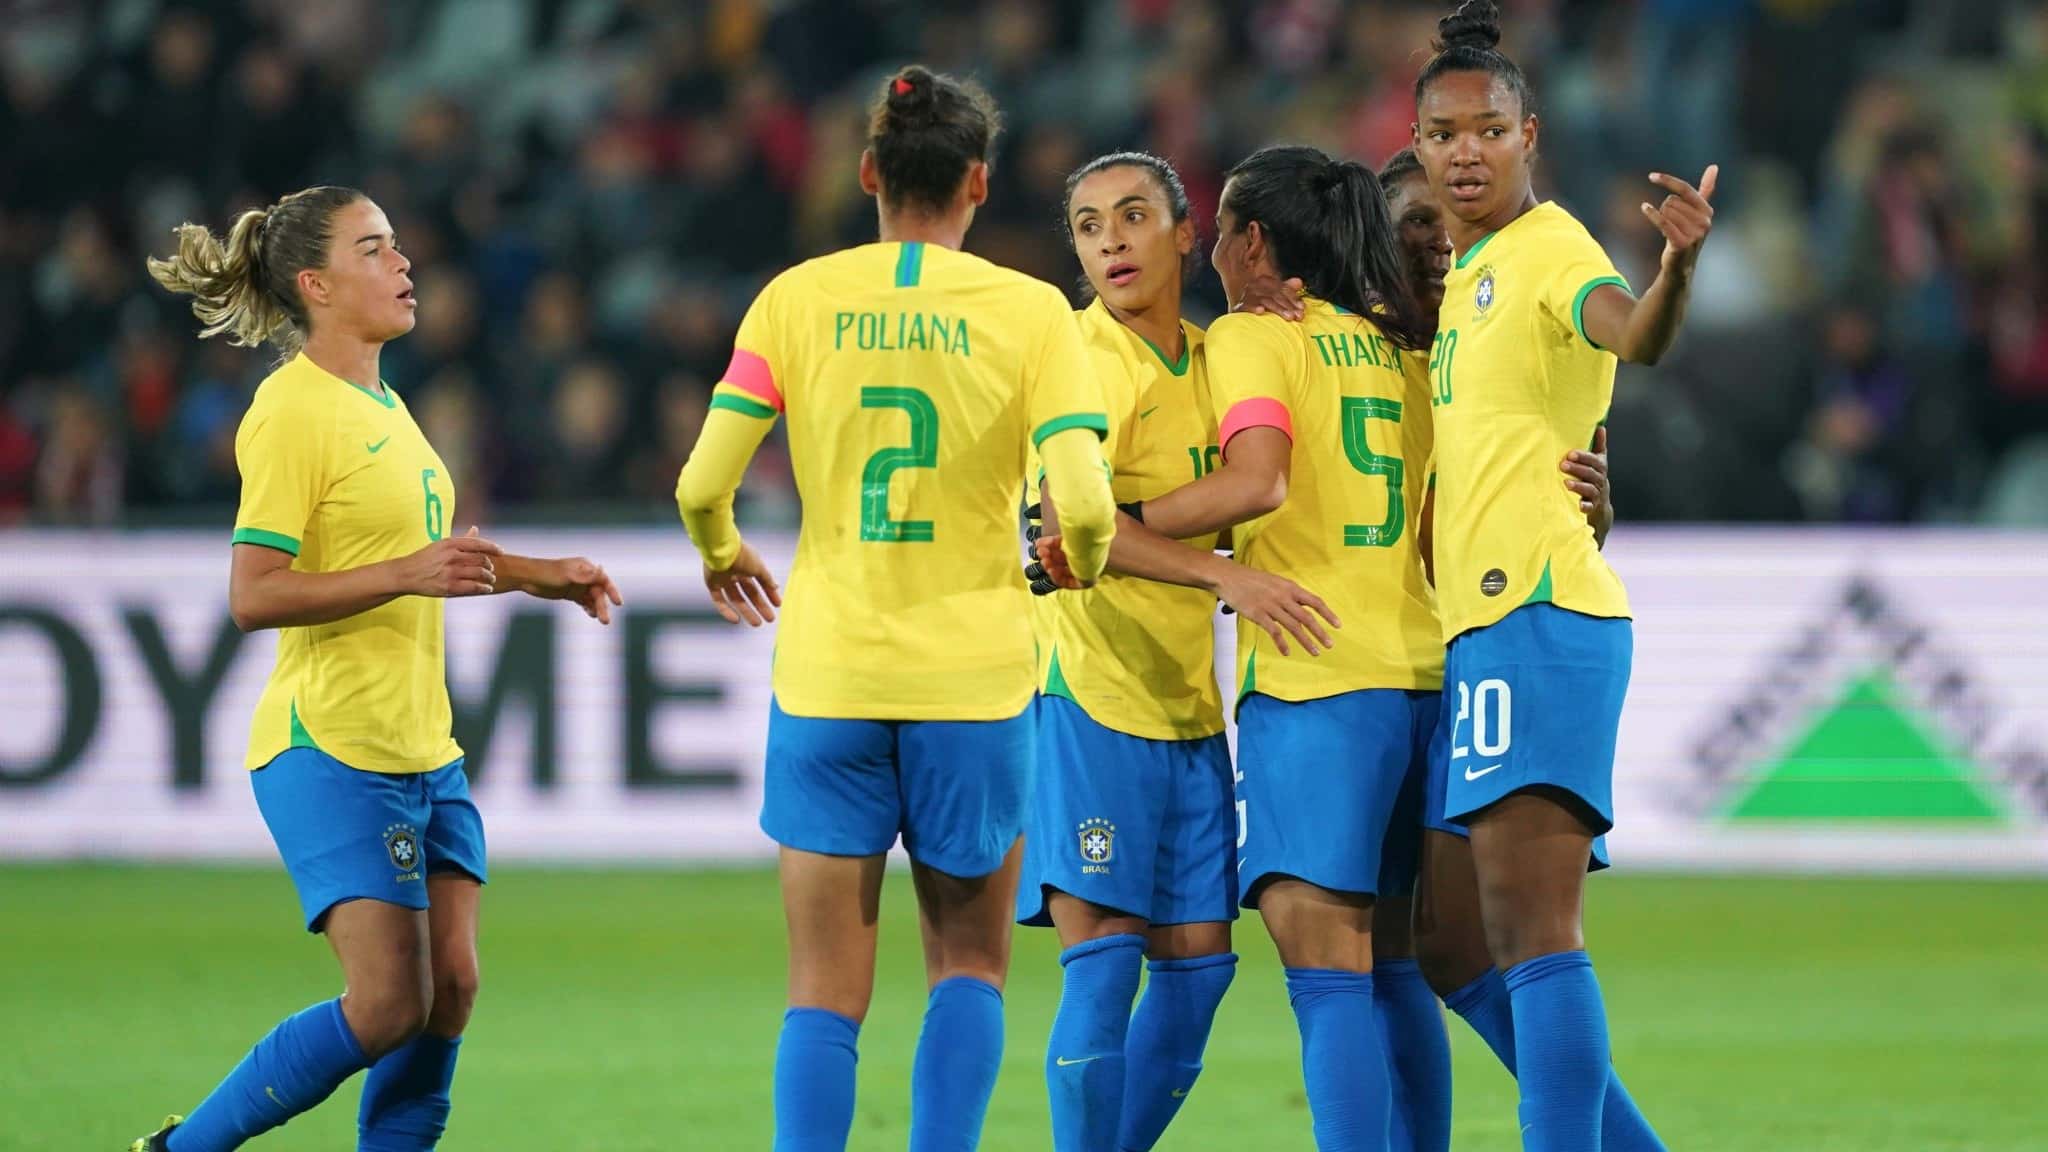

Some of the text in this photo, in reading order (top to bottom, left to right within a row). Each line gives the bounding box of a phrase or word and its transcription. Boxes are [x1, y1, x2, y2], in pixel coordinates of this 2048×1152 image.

[836, 312, 970, 357] POLIANA
[1311, 332, 1405, 377] THAISA
[1430, 329, 1457, 407] 20
[861, 386, 939, 542] 2
[1341, 396, 1405, 547] 5
[422, 468, 442, 541] 6
[1452, 679, 1511, 757] 20
